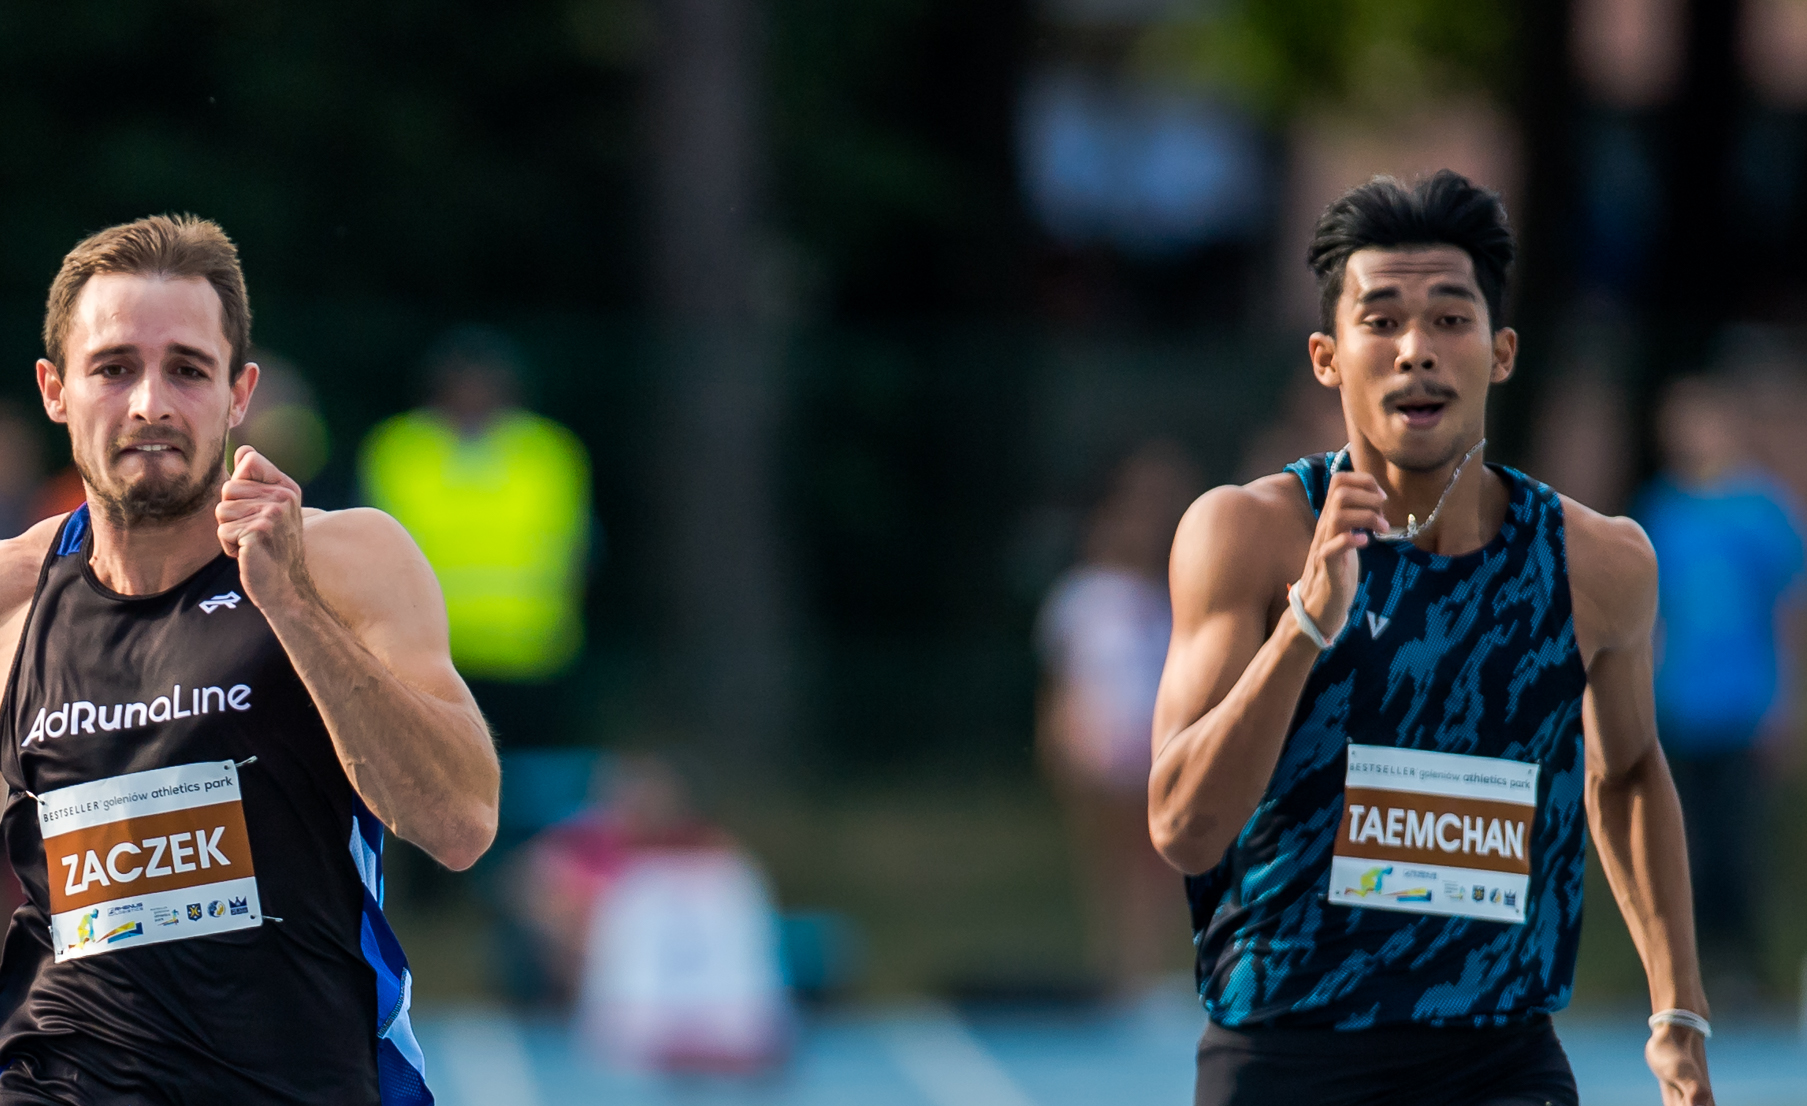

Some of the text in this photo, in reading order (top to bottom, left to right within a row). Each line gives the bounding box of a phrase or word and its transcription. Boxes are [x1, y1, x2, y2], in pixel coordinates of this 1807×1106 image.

[21, 683, 252, 747] AdRunaLine
[43, 776, 234, 823] BESTSELLER goleniów athletics park
[1349, 763, 1416, 776] BESTSELLER
[1463, 774, 1507, 786] athletics
[1510, 779, 1531, 790] park
[1348, 805, 1525, 860] TAEMCHAN
[61, 826, 231, 896] ZACZEK
